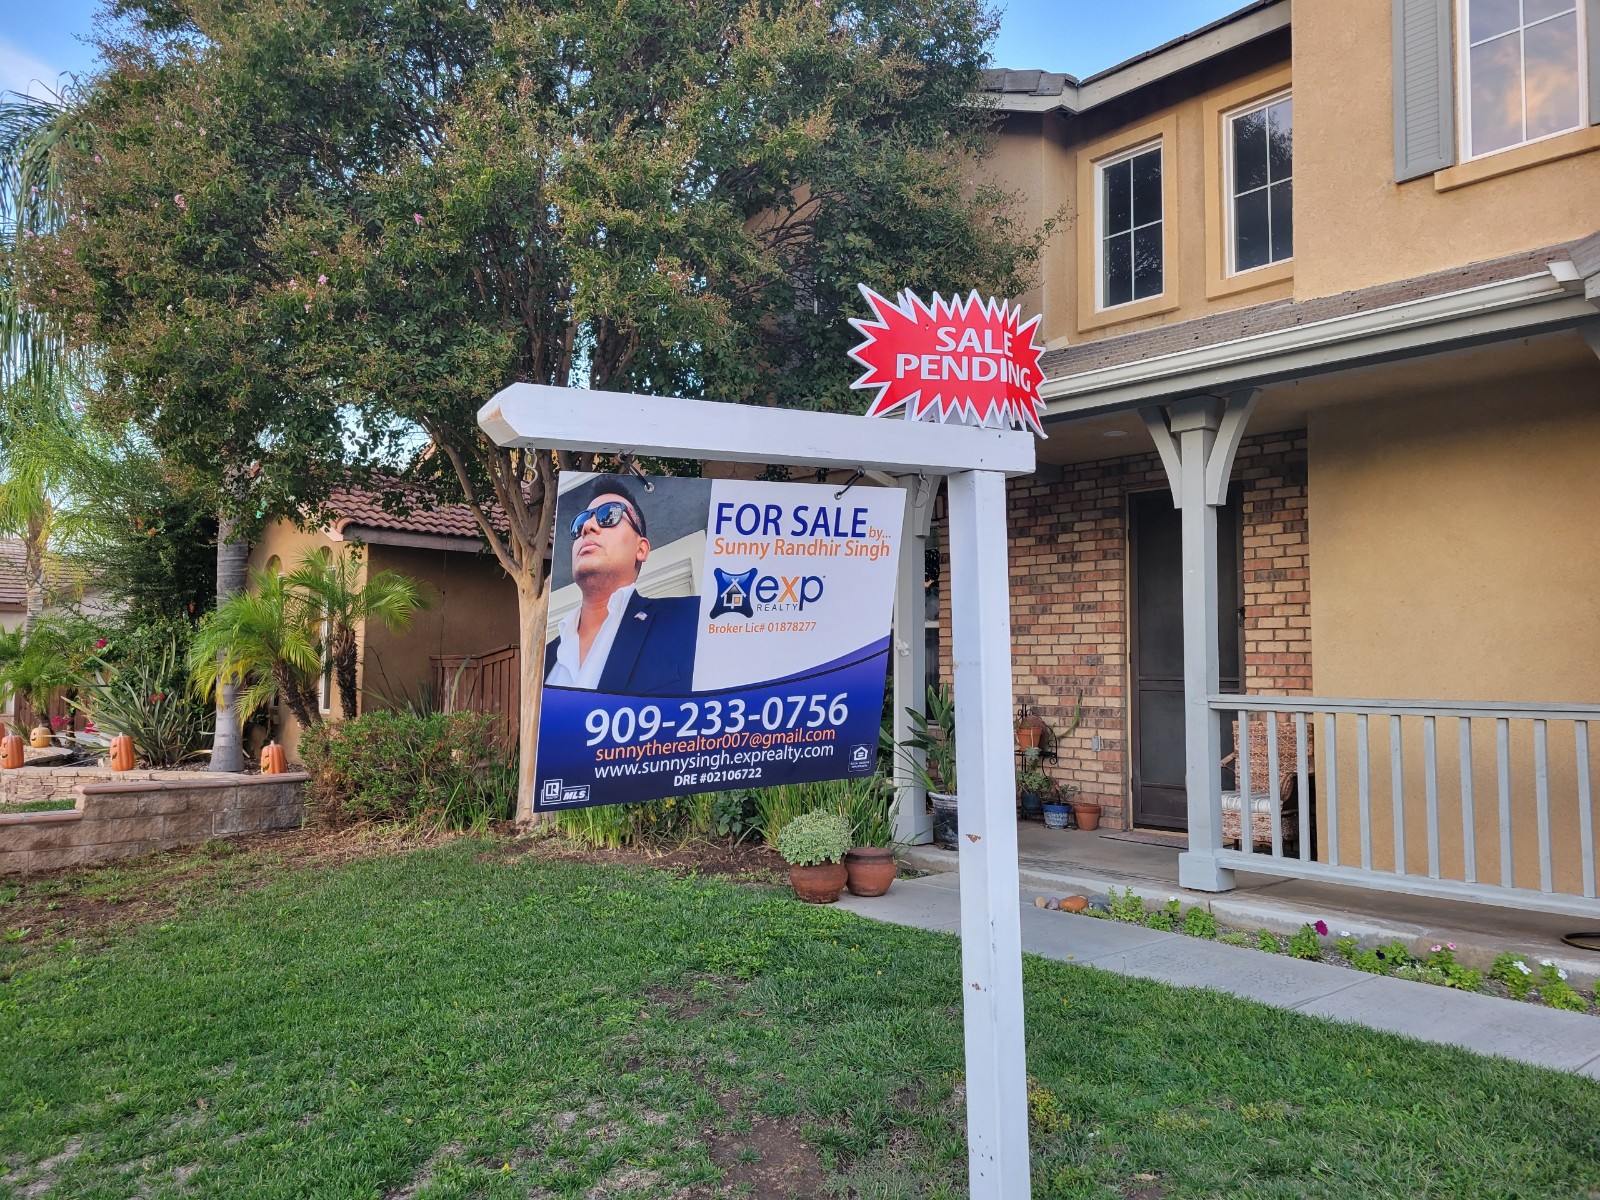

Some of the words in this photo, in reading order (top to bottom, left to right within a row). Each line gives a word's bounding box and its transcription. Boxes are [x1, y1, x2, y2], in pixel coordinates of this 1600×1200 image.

[935, 326, 1014, 357] SALE
[896, 353, 1031, 392] PENDING
[715, 502, 783, 536] FOR
[790, 505, 869, 538] SALE
[713, 537, 770, 560] Sunny
[774, 538, 841, 557] Randhir
[844, 540, 890, 561] Singh
[756, 603, 799, 612] REALTY
[708, 623, 743, 634] Broker
[745, 623, 765, 633] Lic#
[767, 622, 817, 633] 01878277
[584, 692, 849, 747] 909-233-0756
[595, 727, 836, 762] sunnytherealtor007@gmail.com
[594, 743, 834, 779] www.sunnysingh.exprealty.com
[673, 774, 698, 787] DRE
[699, 767, 762, 784] #02106722
[562, 790, 587, 801] MLS
